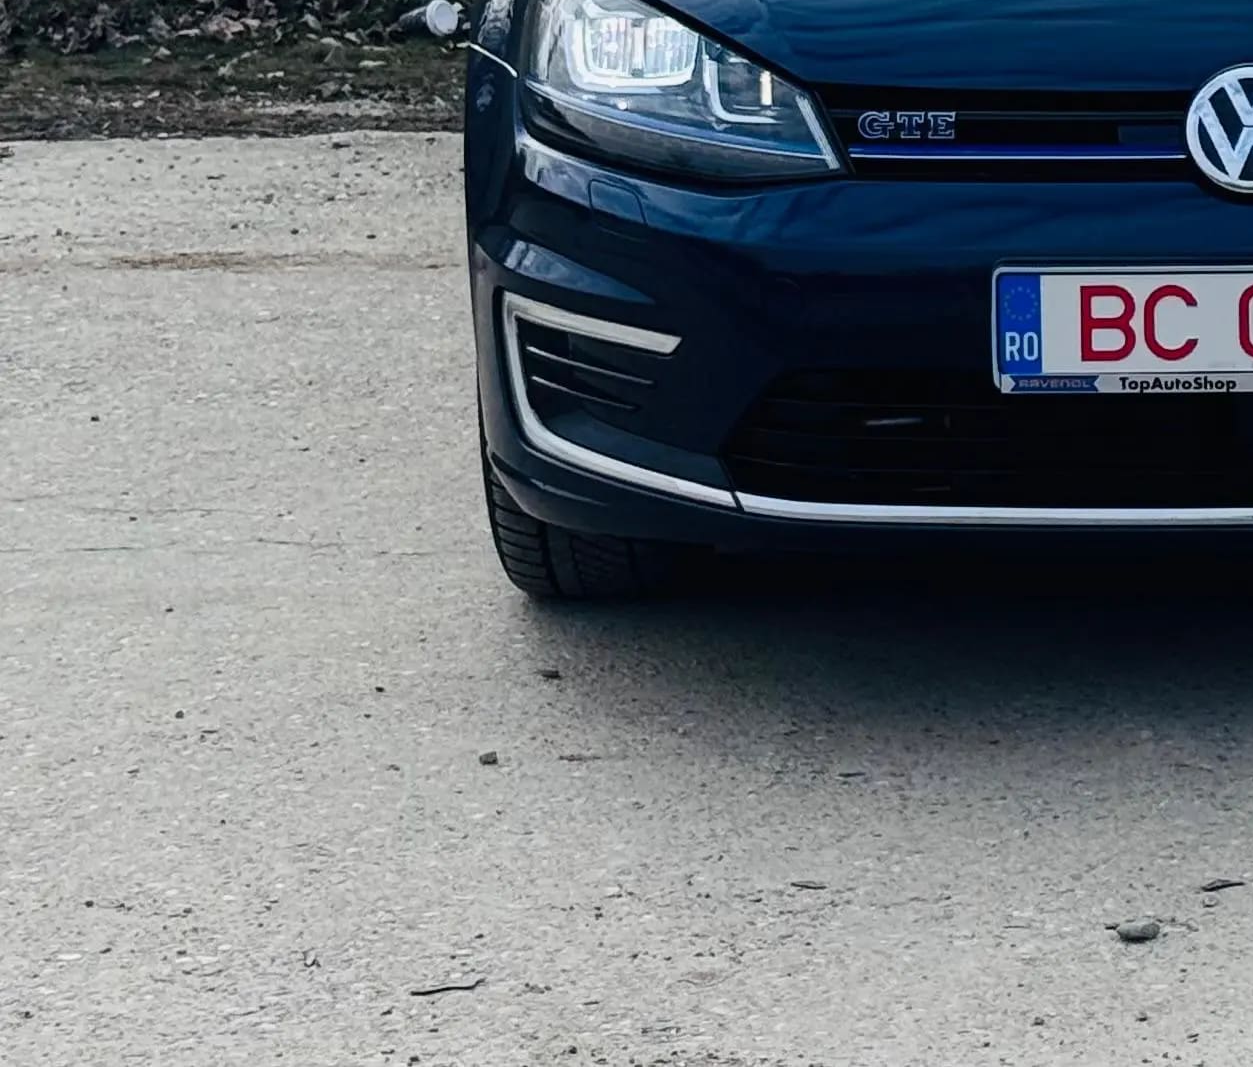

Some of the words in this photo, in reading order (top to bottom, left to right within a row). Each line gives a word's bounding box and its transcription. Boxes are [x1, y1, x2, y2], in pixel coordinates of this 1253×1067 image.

[858, 111, 956, 139] GTE
[1080, 285, 1199, 362] BC
[1005, 331, 1039, 361] RO
[1119, 375, 1237, 393] TopAutoShop
